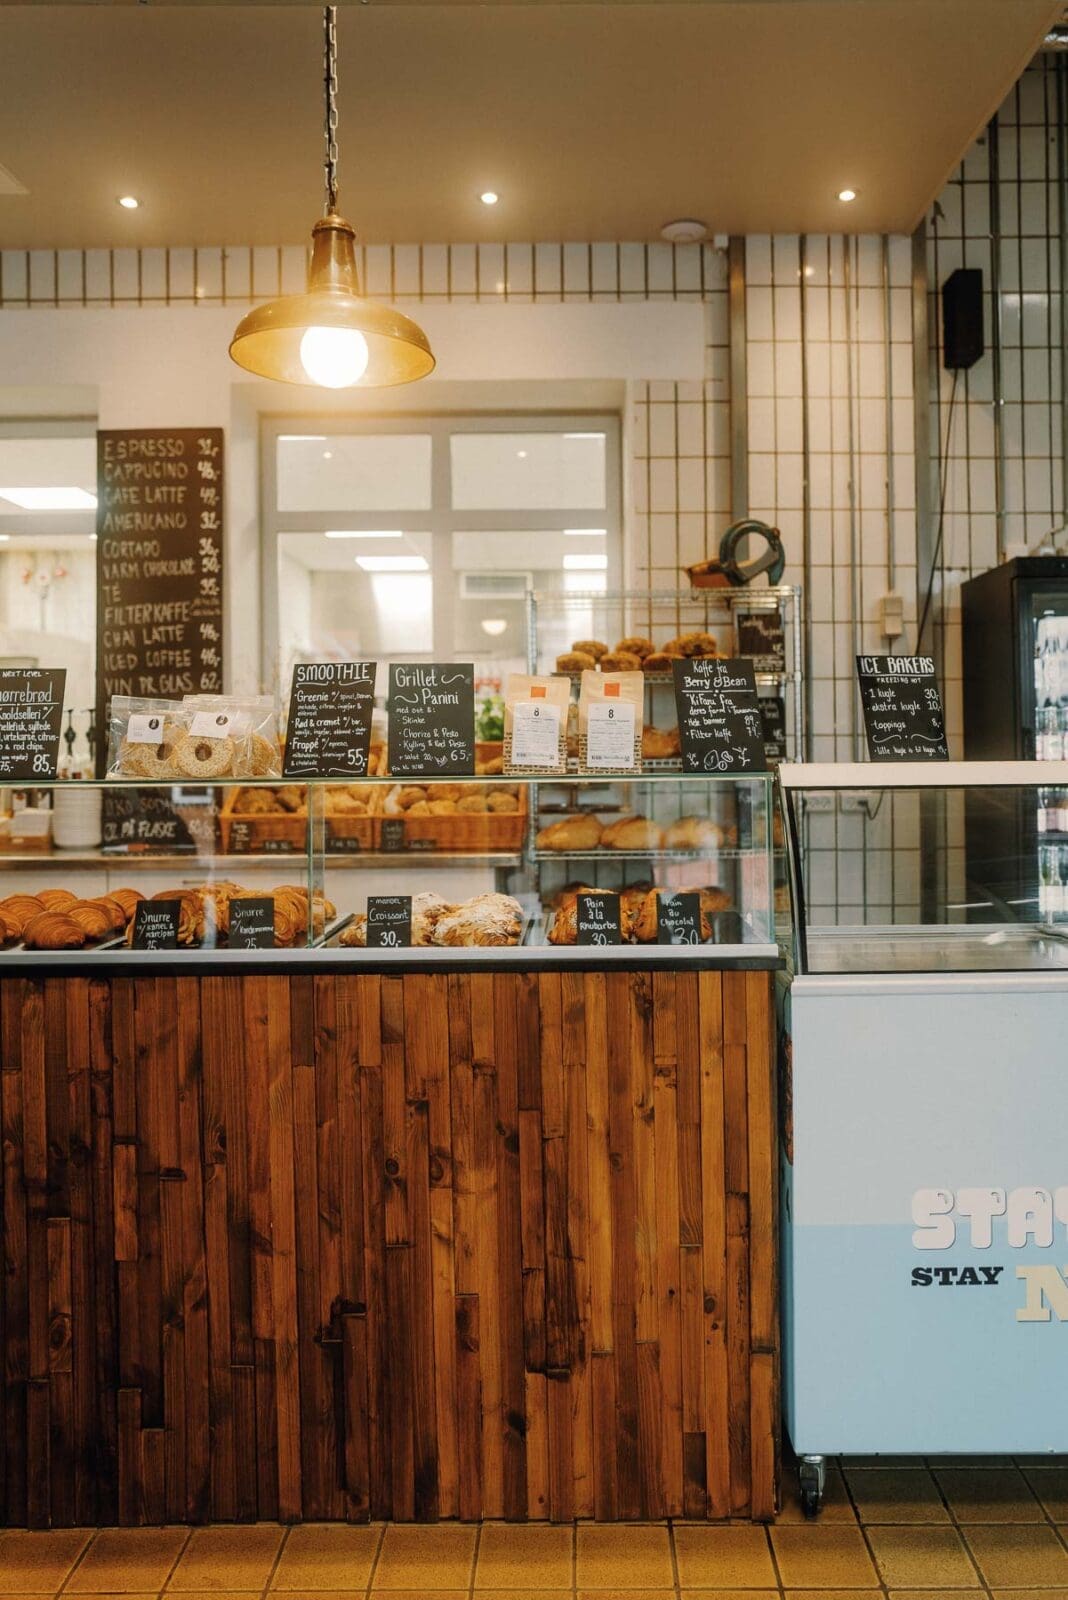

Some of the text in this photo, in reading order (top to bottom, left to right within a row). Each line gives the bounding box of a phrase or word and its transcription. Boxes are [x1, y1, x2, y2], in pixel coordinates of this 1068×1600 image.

[104, 439, 185, 460] ESPRESSO
[104, 461, 188, 482] CAPPUCINO
[145, 486, 187, 504] LATTE
[103, 512, 188, 532] AMERICANO
[103, 539, 160, 558] CORTADO
[142, 624, 184, 645] LATTE
[104, 653, 138, 672] ICED
[146, 649, 192, 668] COFFEE
[693, 660, 728, 678] Kaffe fra
[860, 657, 934, 674] ICE BAKERS
[2, 670, 42, 678] NEXT LEVEL
[297, 664, 370, 682] SMOOTHIE
[395, 667, 438, 688] Grillet
[684, 676, 710, 689] Berry
[722, 676, 746, 688] Bean
[296, 690, 328, 702] Greenie
[422, 688, 459, 705] Panini
[877, 688, 896, 702] kugle
[608, 709, 614, 718] 8
[872, 702, 897, 712] ekstra
[900, 701, 920, 716] kugle
[402, 716, 426, 724] Skinke
[873, 720, 906, 732] toppings
[403, 728, 459, 738] Chorizo & Pesto
[690, 729, 712, 740] Filter
[33, 754, 55, 774] 85,-
[347, 748, 368, 768] 55,-
[235, 901, 264, 918] Snurre
[584, 898, 604, 908] Pain
[380, 931, 402, 948] 30,-
[912, 1266, 1004, 1286] STAY
